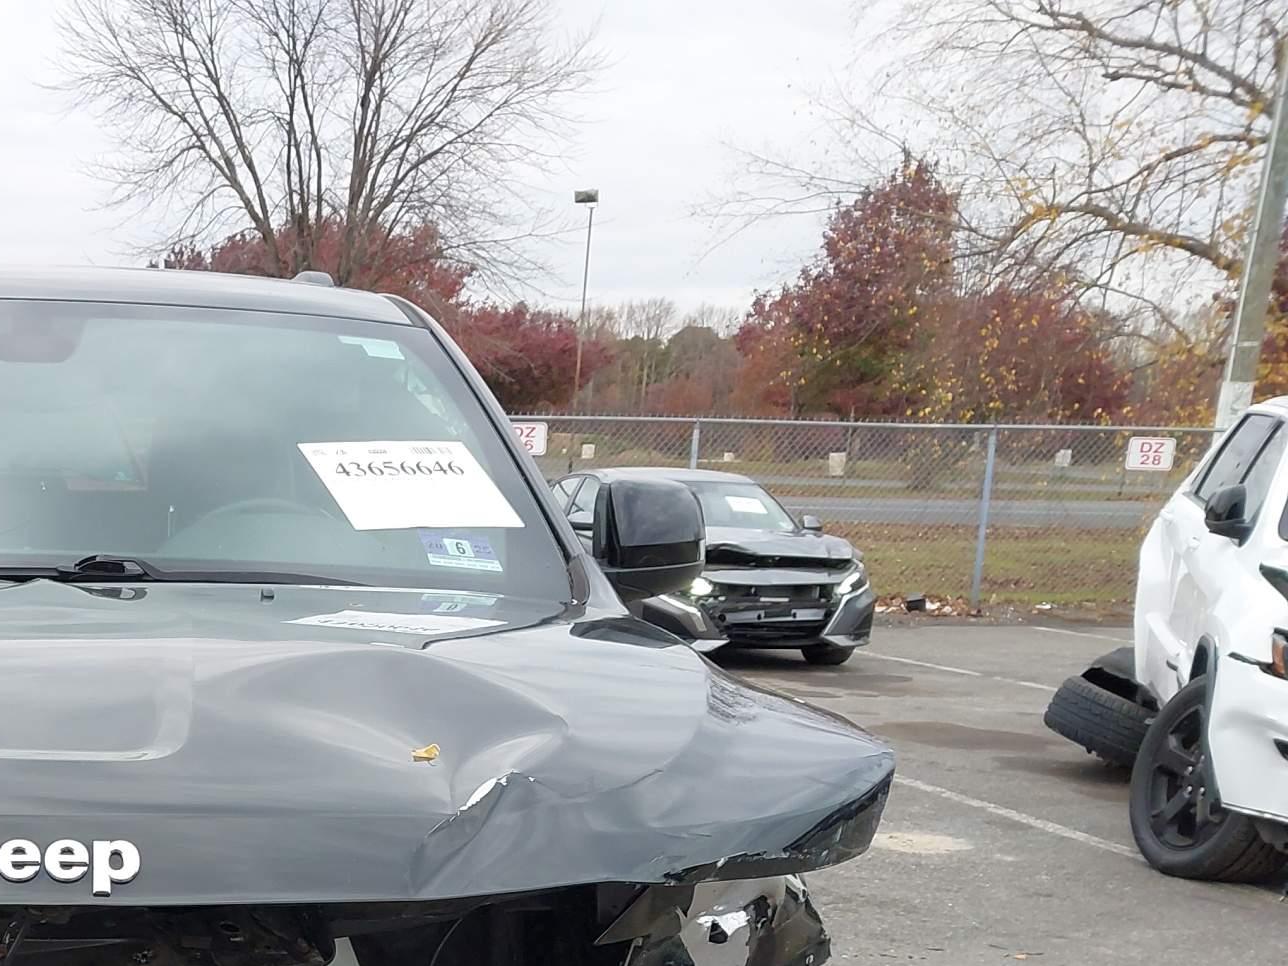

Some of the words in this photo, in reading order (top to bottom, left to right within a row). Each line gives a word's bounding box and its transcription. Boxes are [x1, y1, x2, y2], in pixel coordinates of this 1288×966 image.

[1140, 442, 1166, 454] DZ
[1140, 454, 1162, 466] 28
[335, 460, 465, 477] 43656646
[455, 541, 467, 555] 6
